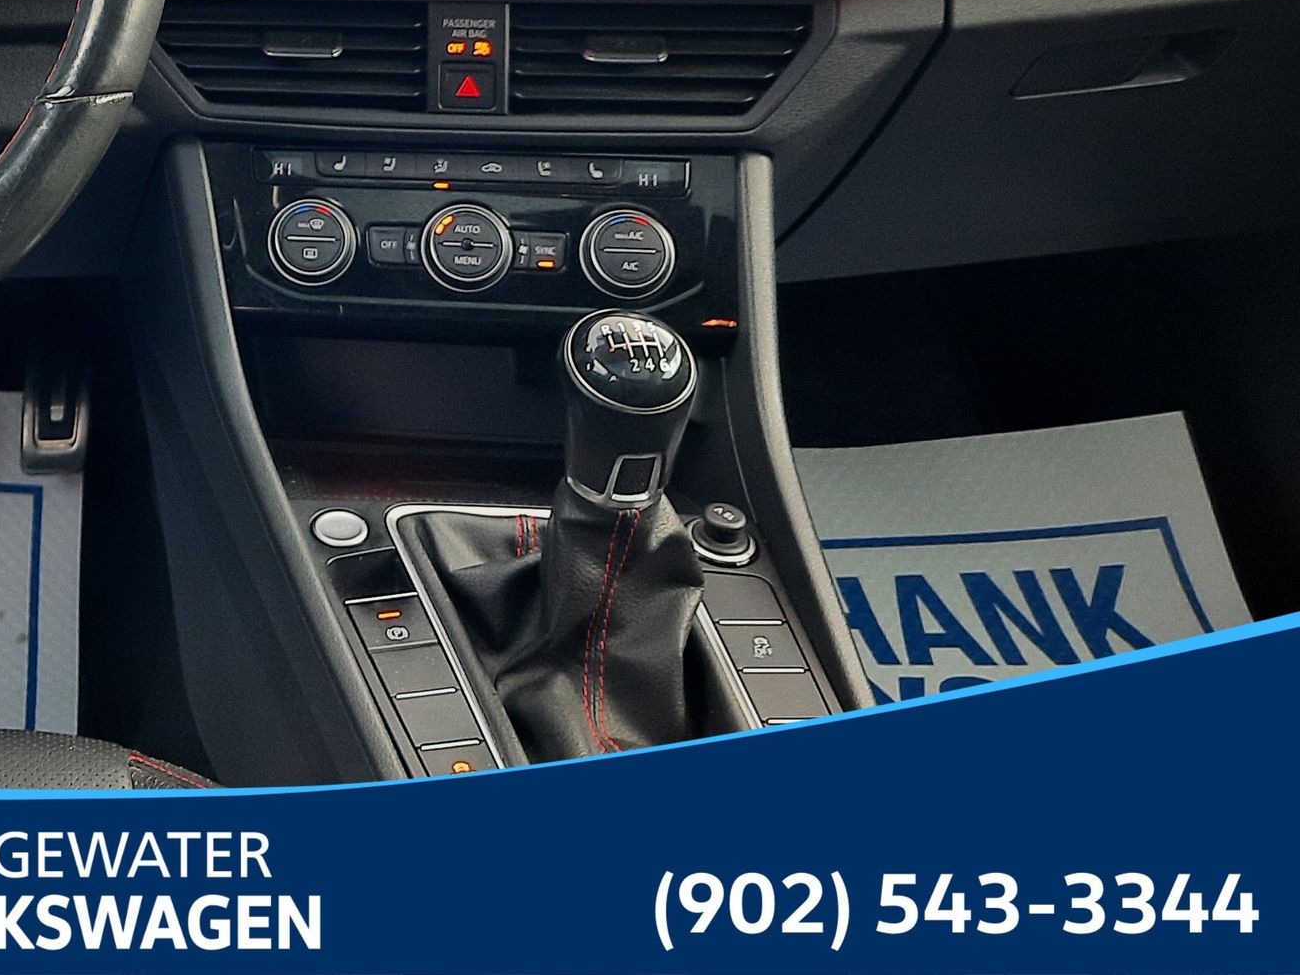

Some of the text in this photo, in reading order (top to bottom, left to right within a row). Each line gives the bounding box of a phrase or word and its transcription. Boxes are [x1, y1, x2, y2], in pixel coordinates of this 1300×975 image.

[442, 18, 497, 28] PASSENGER
[447, 42, 465, 54] OFF
[454, 225, 481, 234] AUTO
[380, 240, 397, 250] OFF
[454, 256, 482, 266] MENU
[601, 324, 612, 336] R
[629, 357, 670, 373] 2 4 6
